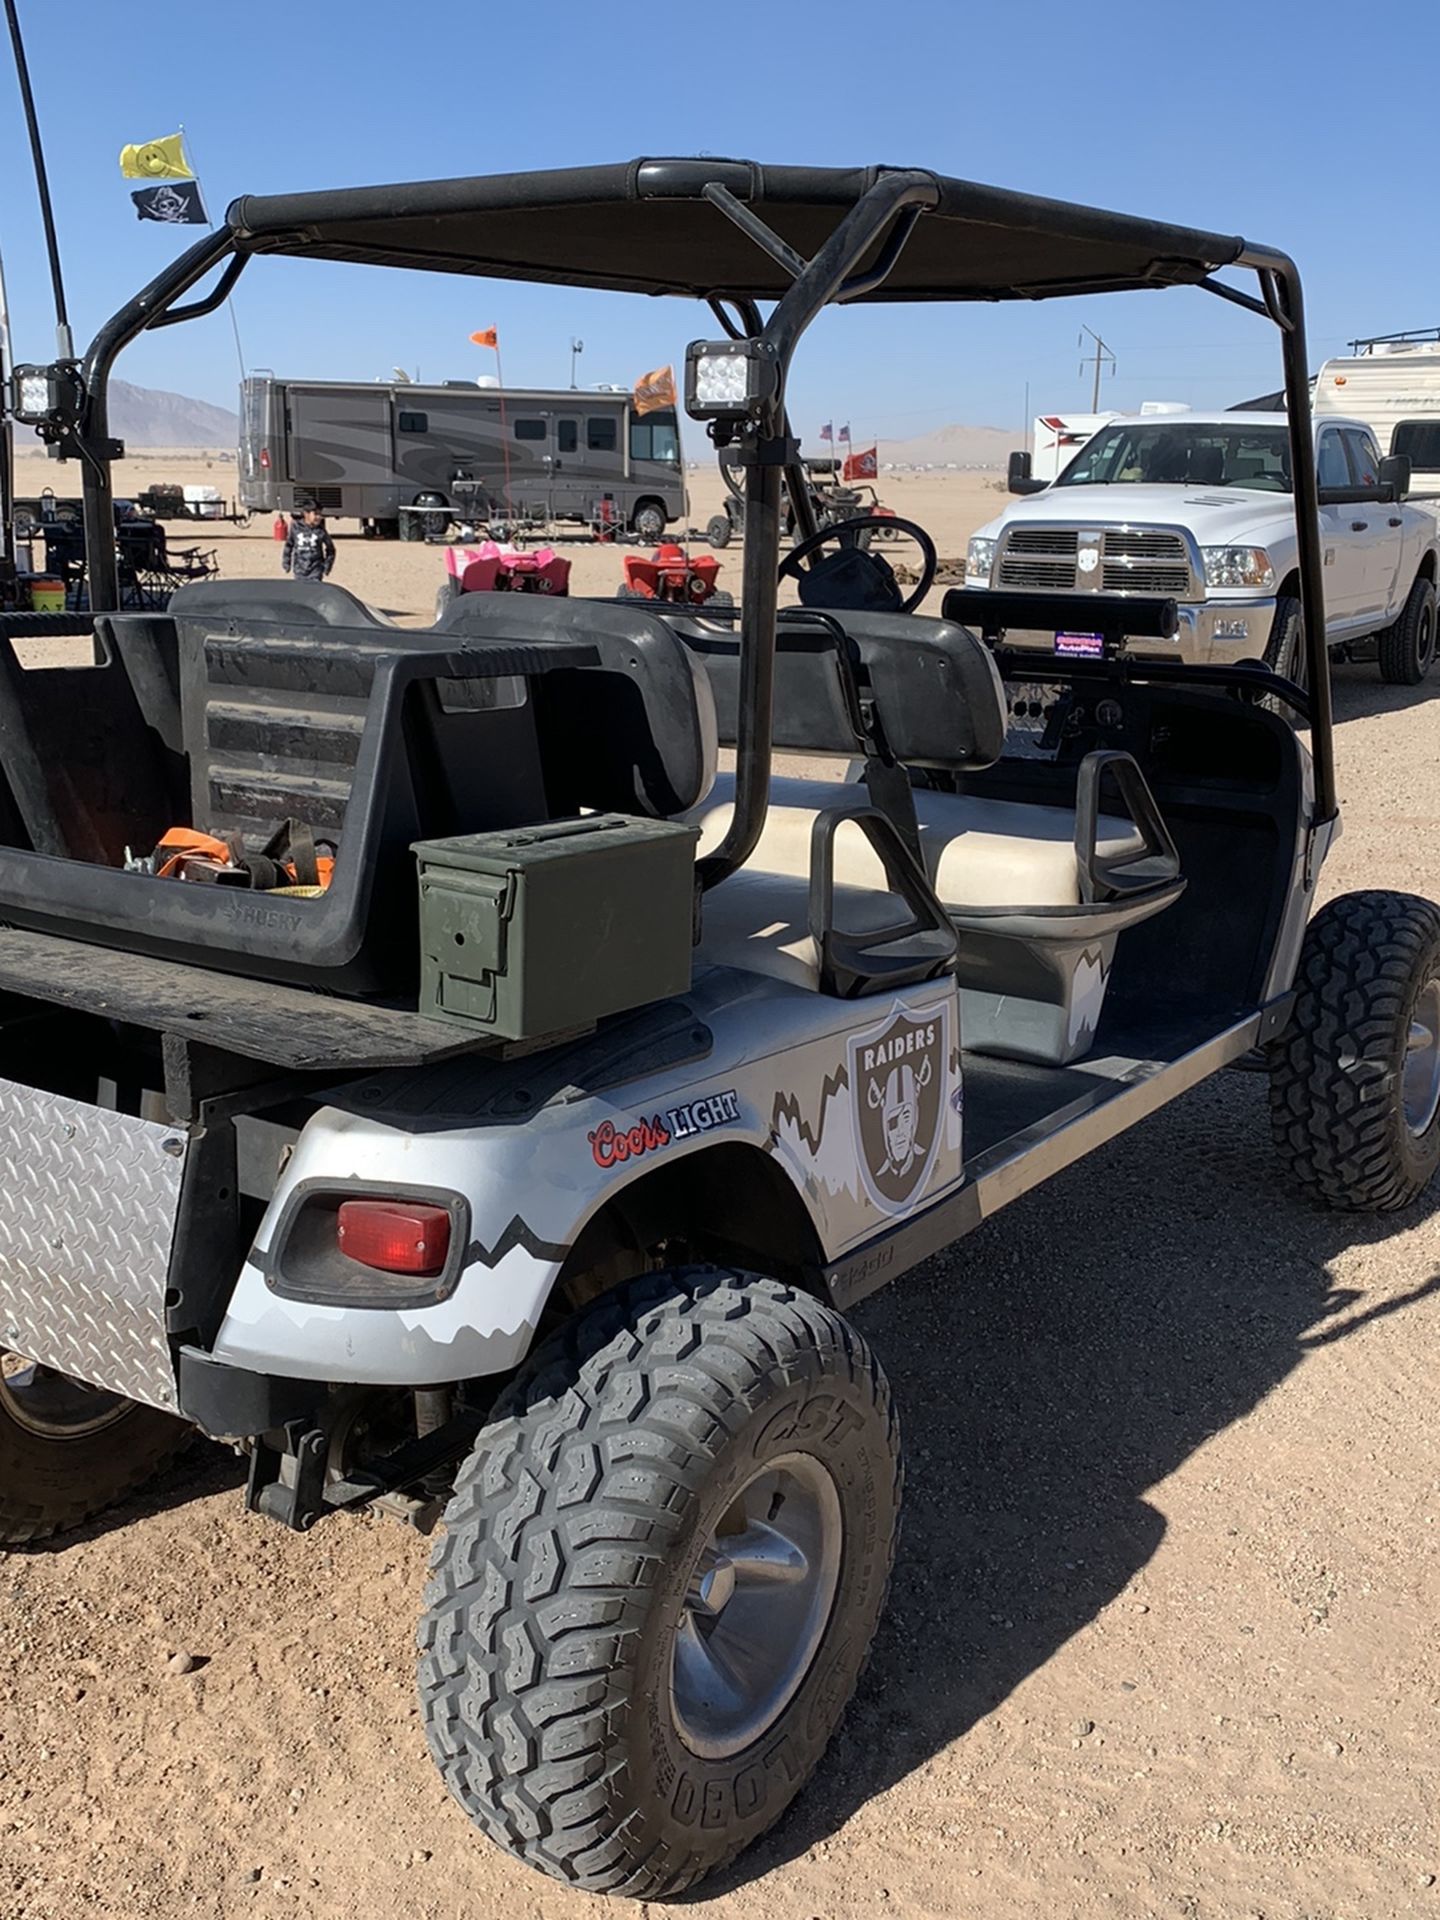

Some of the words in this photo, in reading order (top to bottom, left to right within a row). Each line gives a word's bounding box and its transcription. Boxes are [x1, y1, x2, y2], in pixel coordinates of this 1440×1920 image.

[864, 1024, 936, 1071] RAIDERS
[587, 1114, 671, 1168] Coors
[666, 1089, 741, 1140] LIGHT
[671, 1734, 803, 1829] LOBO
